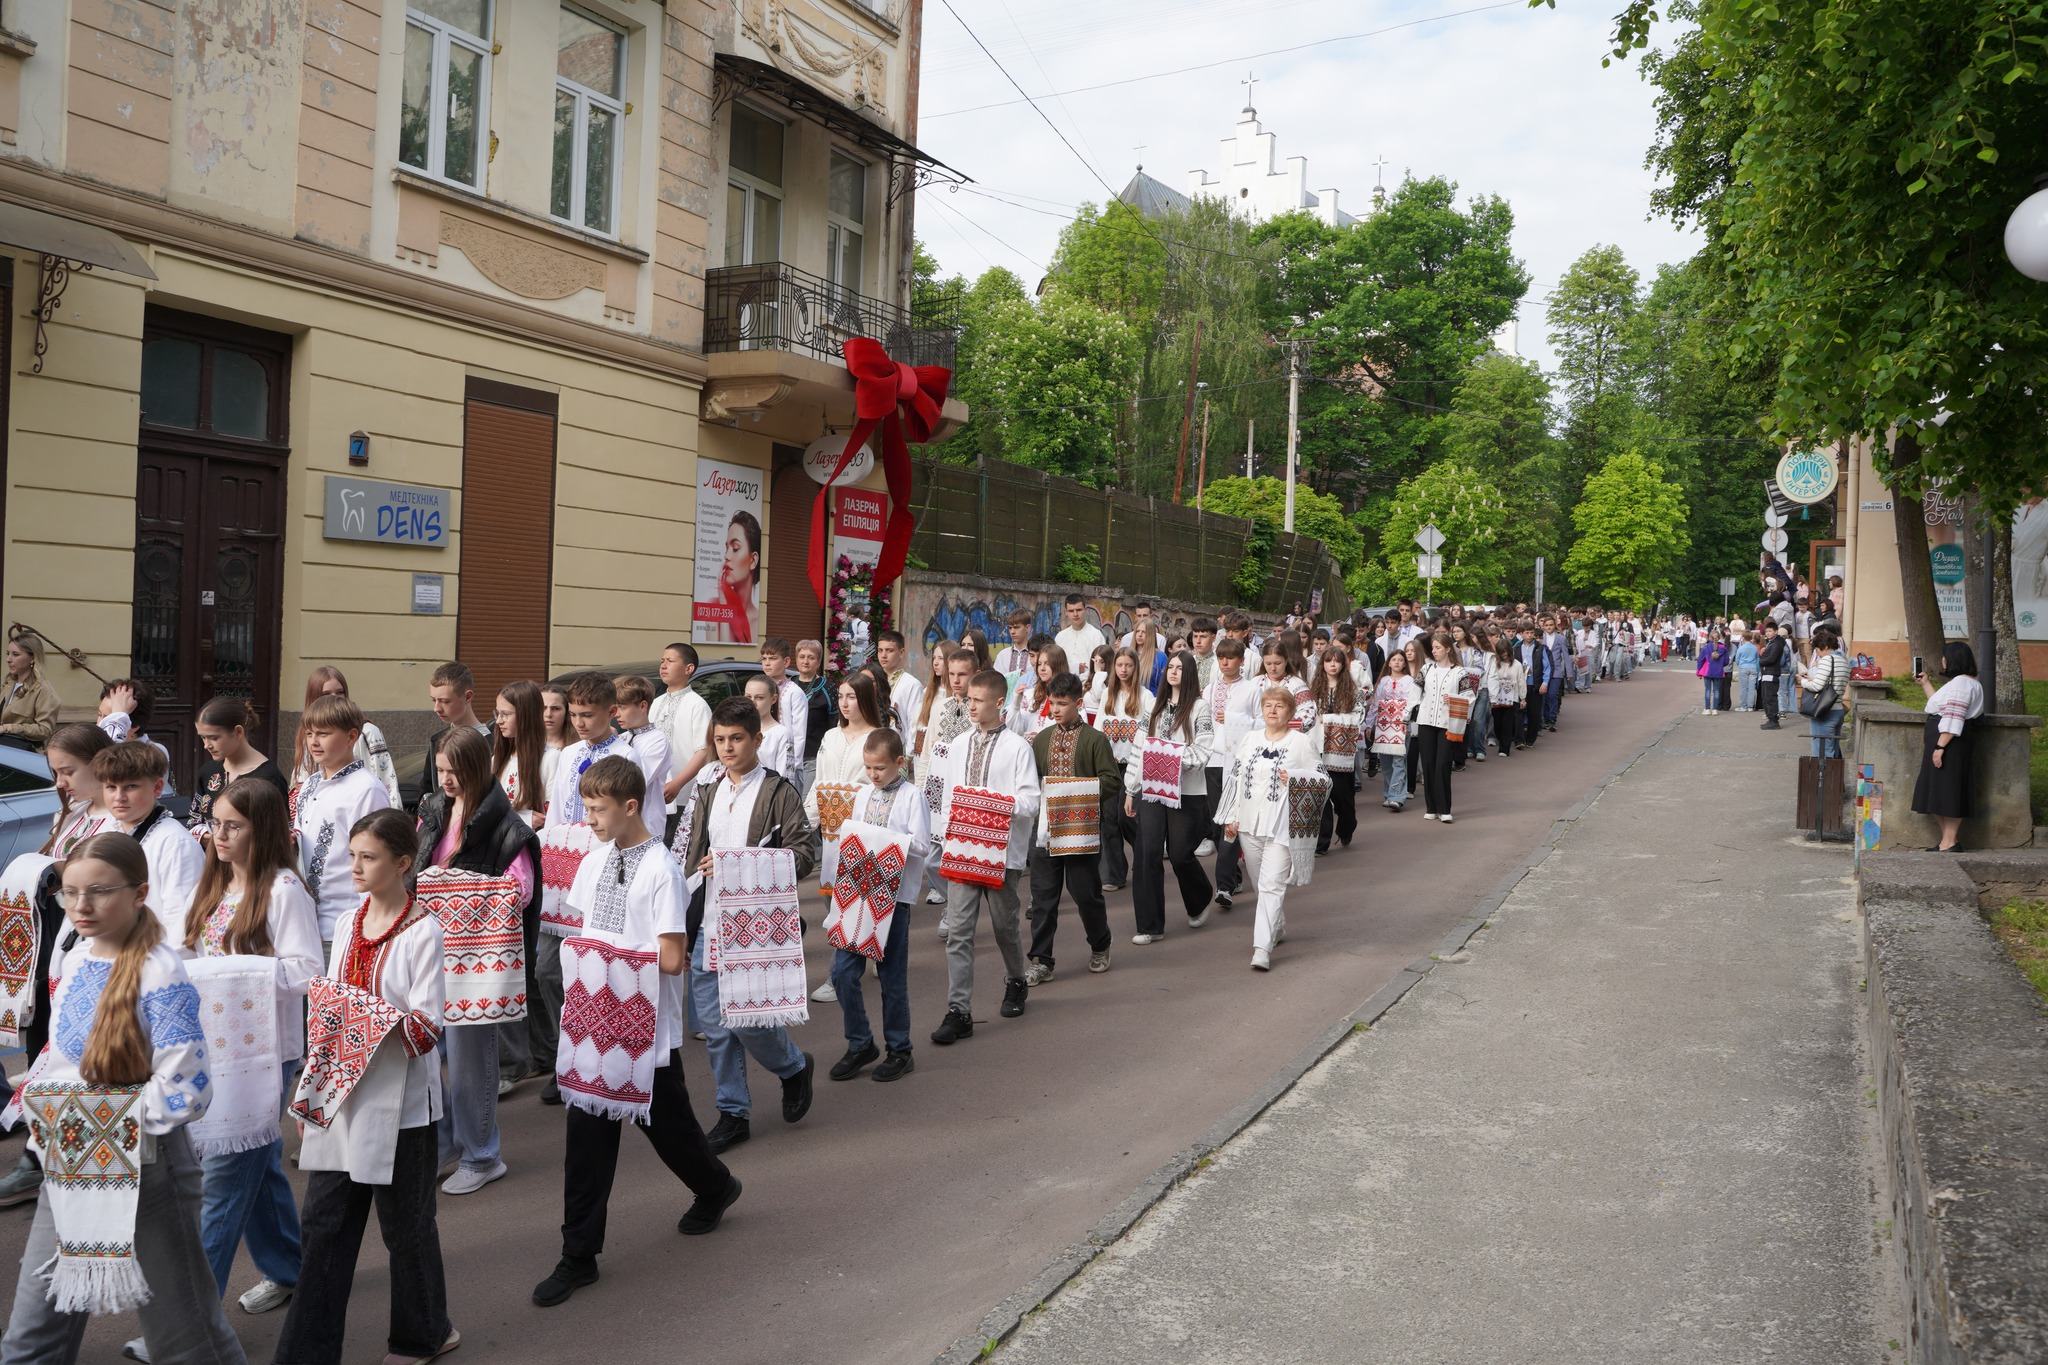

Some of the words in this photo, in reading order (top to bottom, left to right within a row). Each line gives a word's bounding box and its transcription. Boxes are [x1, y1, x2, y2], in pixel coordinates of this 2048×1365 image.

[353, 440, 364, 455] 7
[808, 450, 865, 469] Лазеруз
[703, 470, 759, 501] Лазерхауз
[390, 490, 439, 507] МЕДТЕХНІКА
[844, 497, 880, 515] ЛАЗЕРНА
[1885, 502, 1892, 510] 6
[377, 505, 442, 542] DENS
[843, 514, 880, 533] ЕПІЛЯЦІЯ
